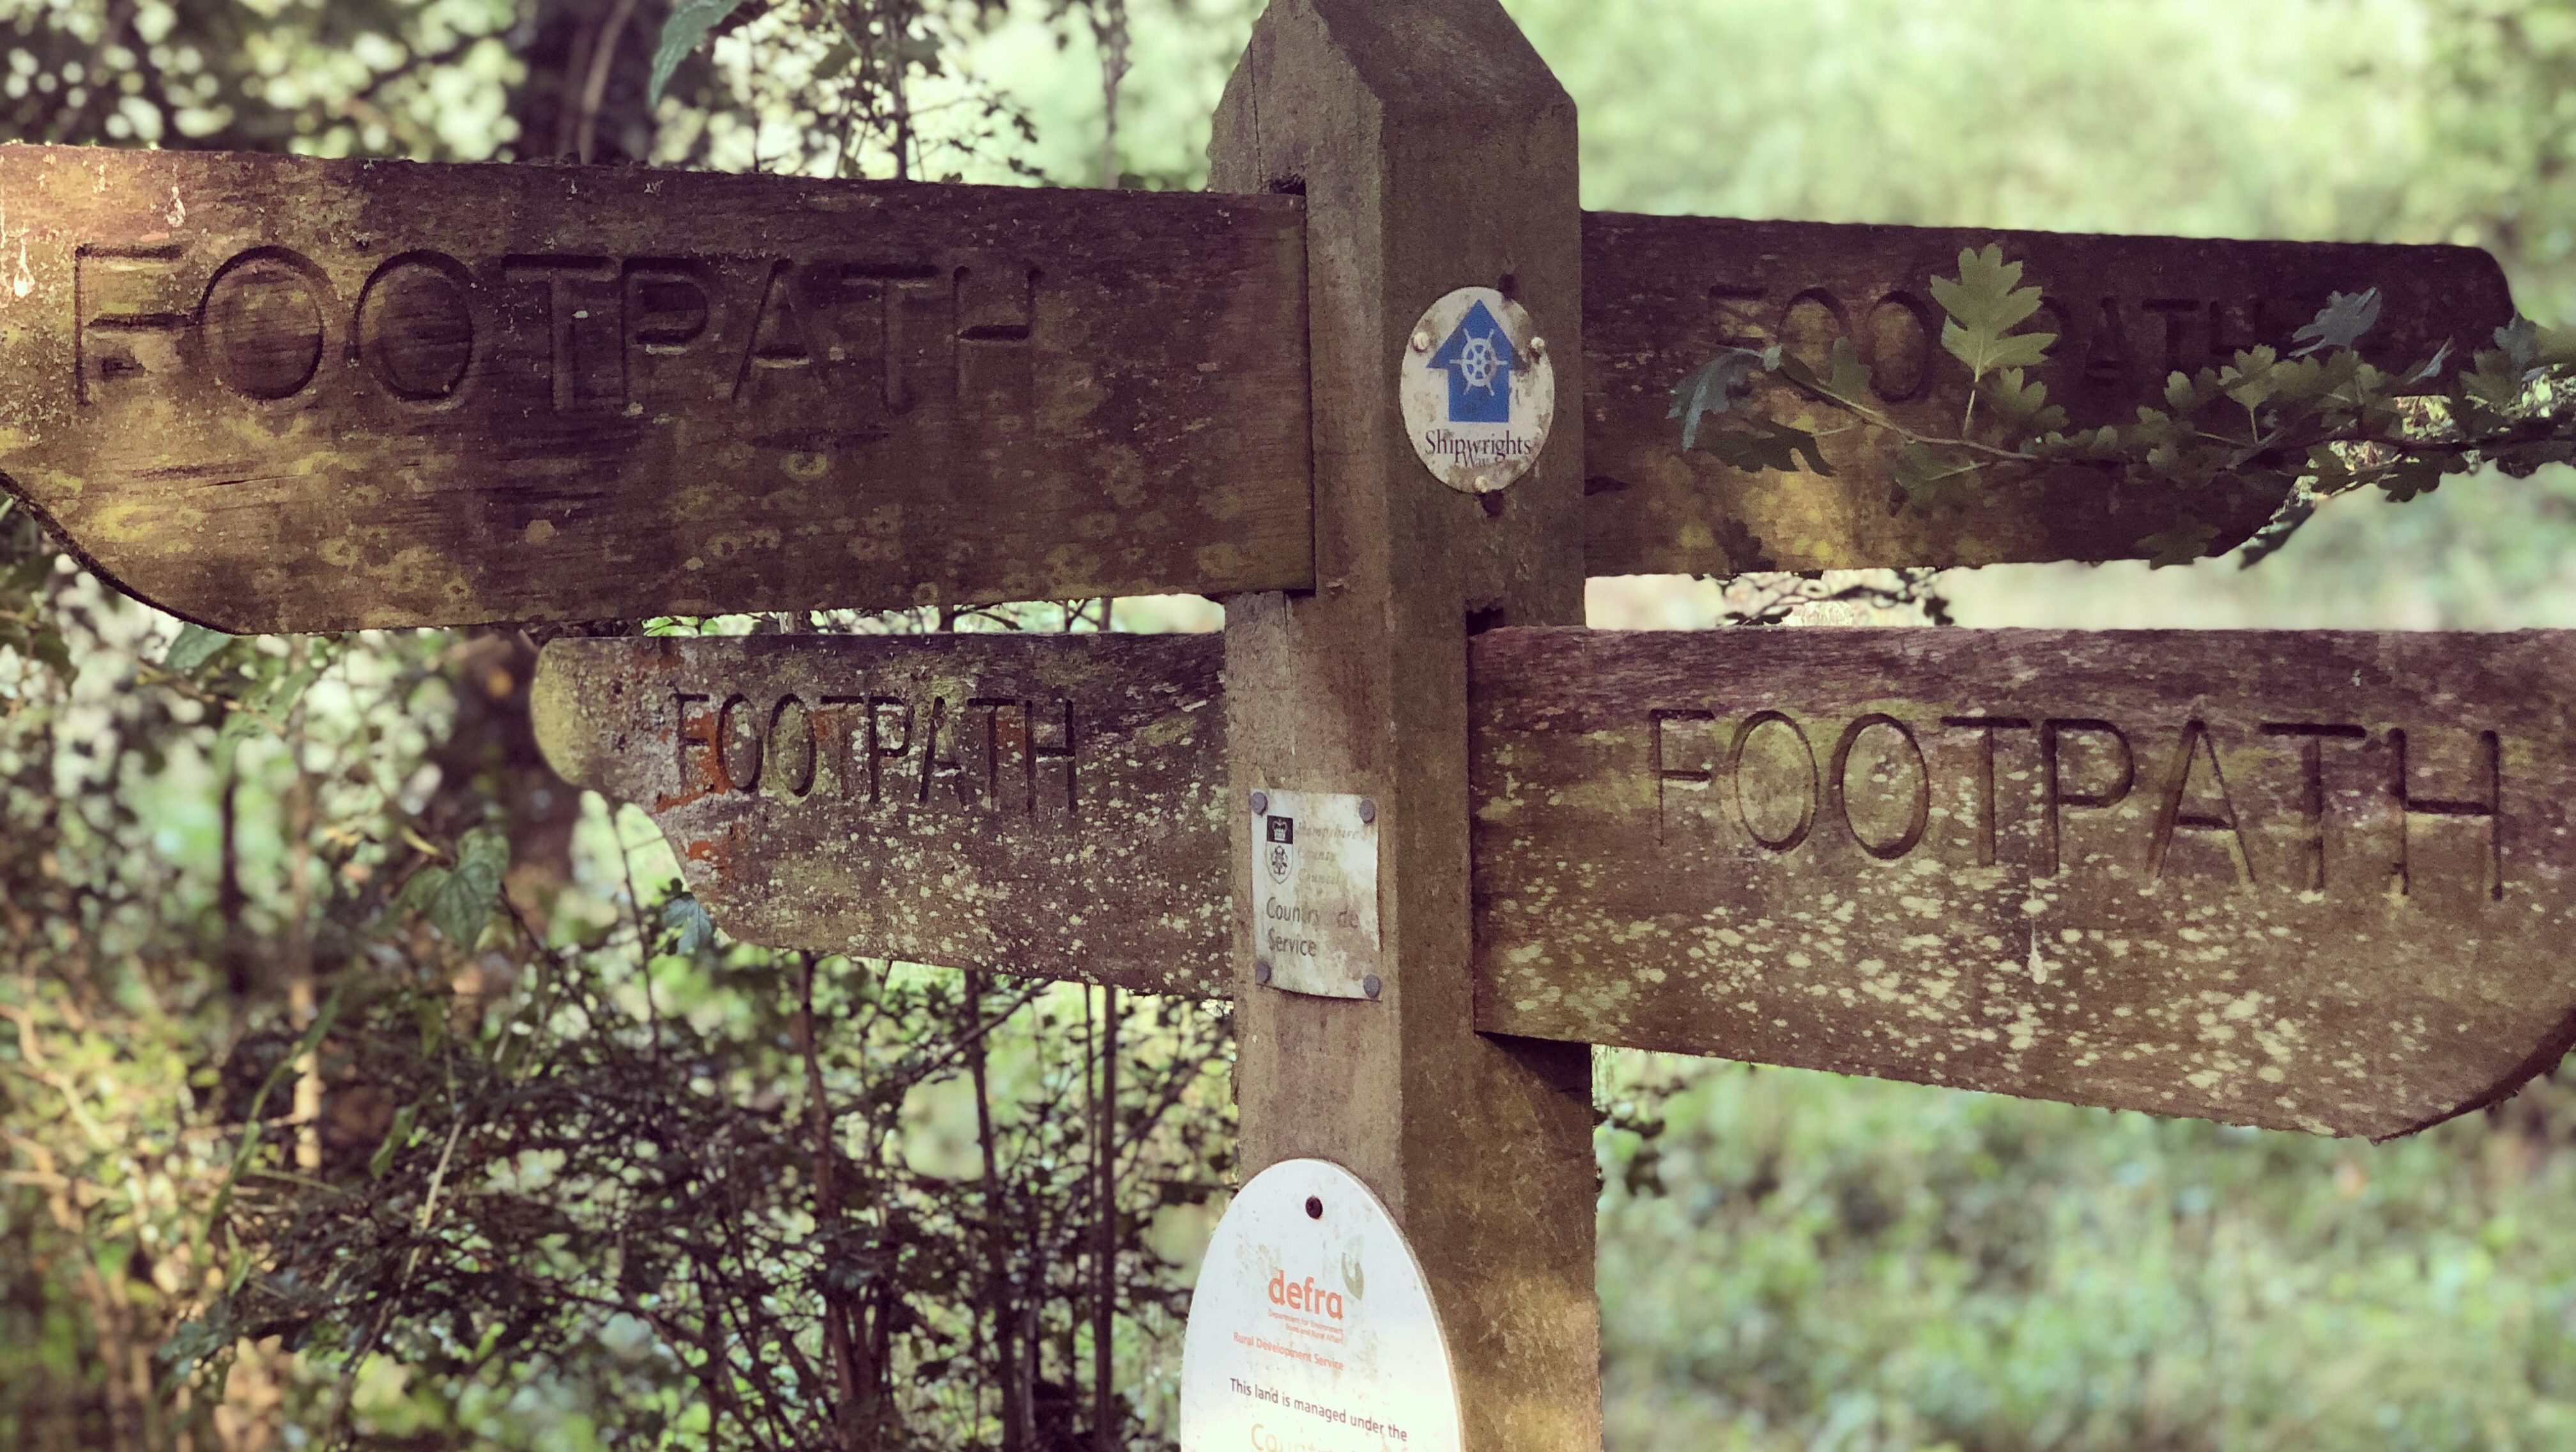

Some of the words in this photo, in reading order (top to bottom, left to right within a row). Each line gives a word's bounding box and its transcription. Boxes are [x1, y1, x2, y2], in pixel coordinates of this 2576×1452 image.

[75, 244, 1044, 415] FOOTPATH
[1425, 429, 1531, 463] Shipwrights
[669, 692, 1078, 815] FOOTPATH
[1648, 706, 2503, 901] FOOTPATH
[1268, 927, 1317, 957] Service
[1268, 1269, 1344, 1320] defra
[1234, 1332, 1254, 1346] Rural
[1256, 1338, 1312, 1362] Development
[1314, 1354, 1344, 1370] Service
[1230, 1377, 1252, 1396] This
[1255, 1384, 1278, 1404] land
[1282, 1391, 1291, 1407] is
[1294, 1399, 1346, 1423] managed
[1350, 1414, 1384, 1435] under
[1388, 1424, 1408, 1442] the
